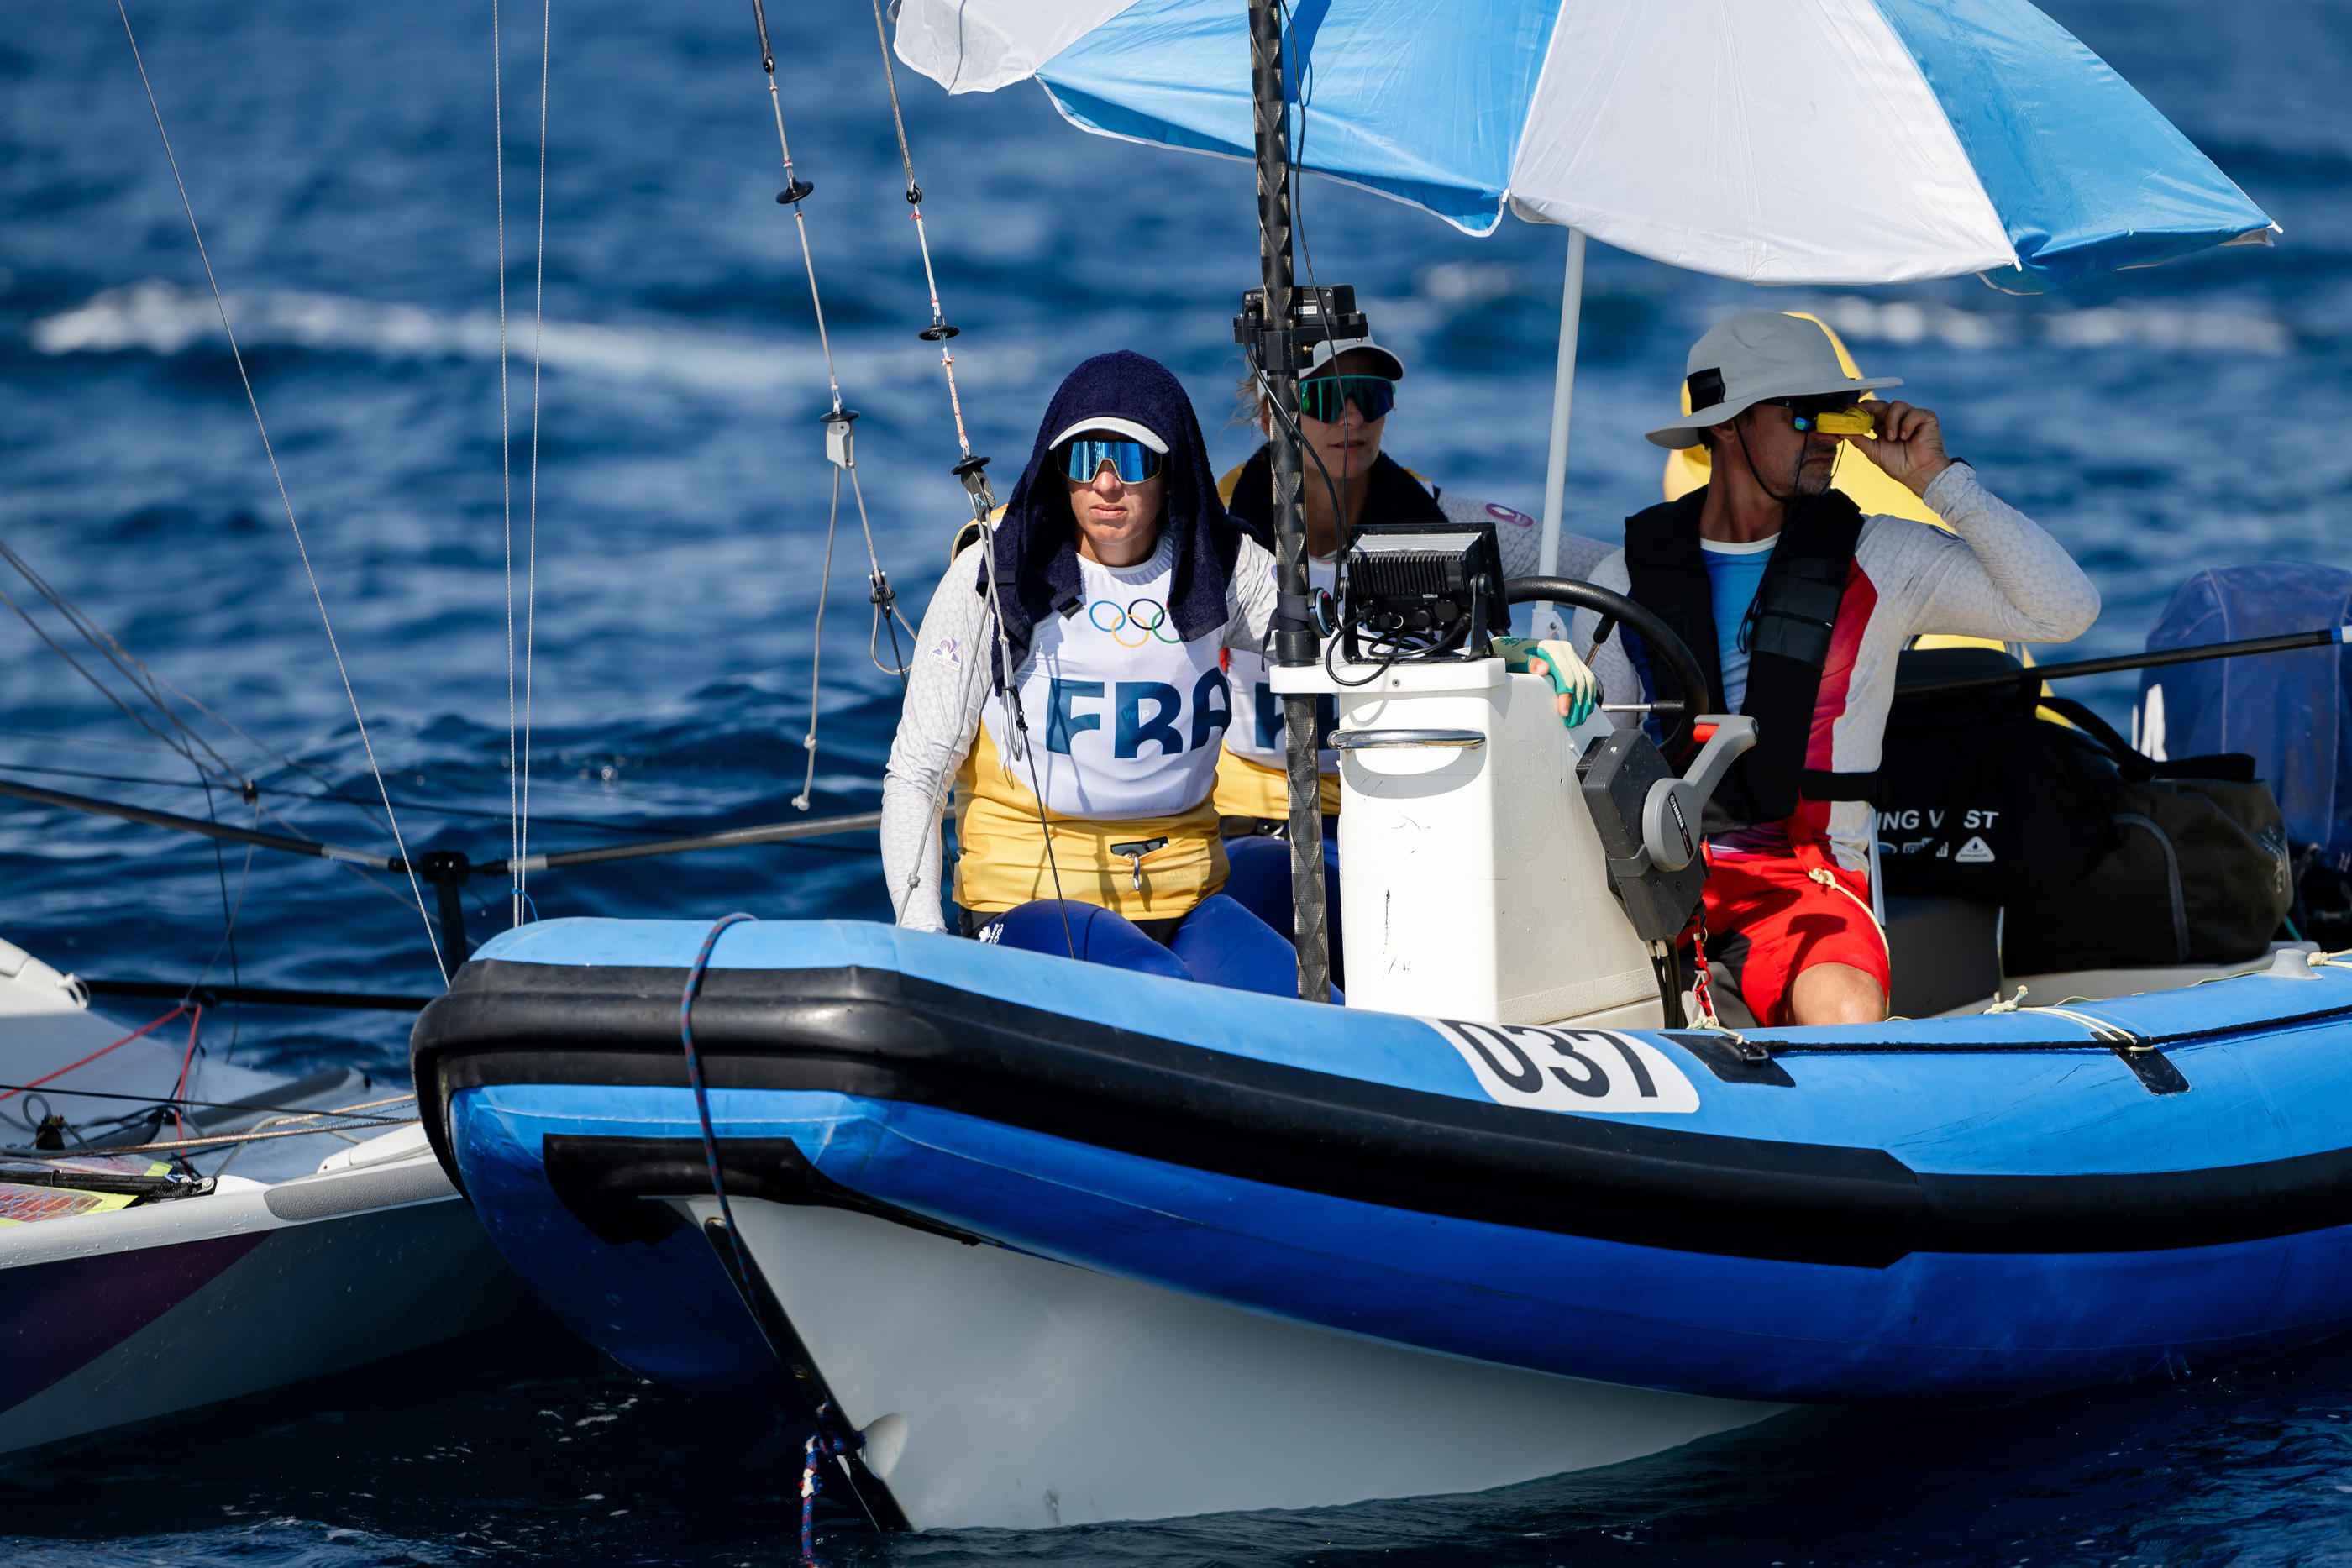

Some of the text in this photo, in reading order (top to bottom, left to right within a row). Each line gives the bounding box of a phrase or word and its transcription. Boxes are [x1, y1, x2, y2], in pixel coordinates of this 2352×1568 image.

[1046, 666, 1232, 759] FRA
[1123, 709, 1151, 720] WIP
[1672, 802, 1684, 829] YAMAHA
[1928, 809, 2000, 830] VST
[1437, 1018, 1659, 1099] 037
